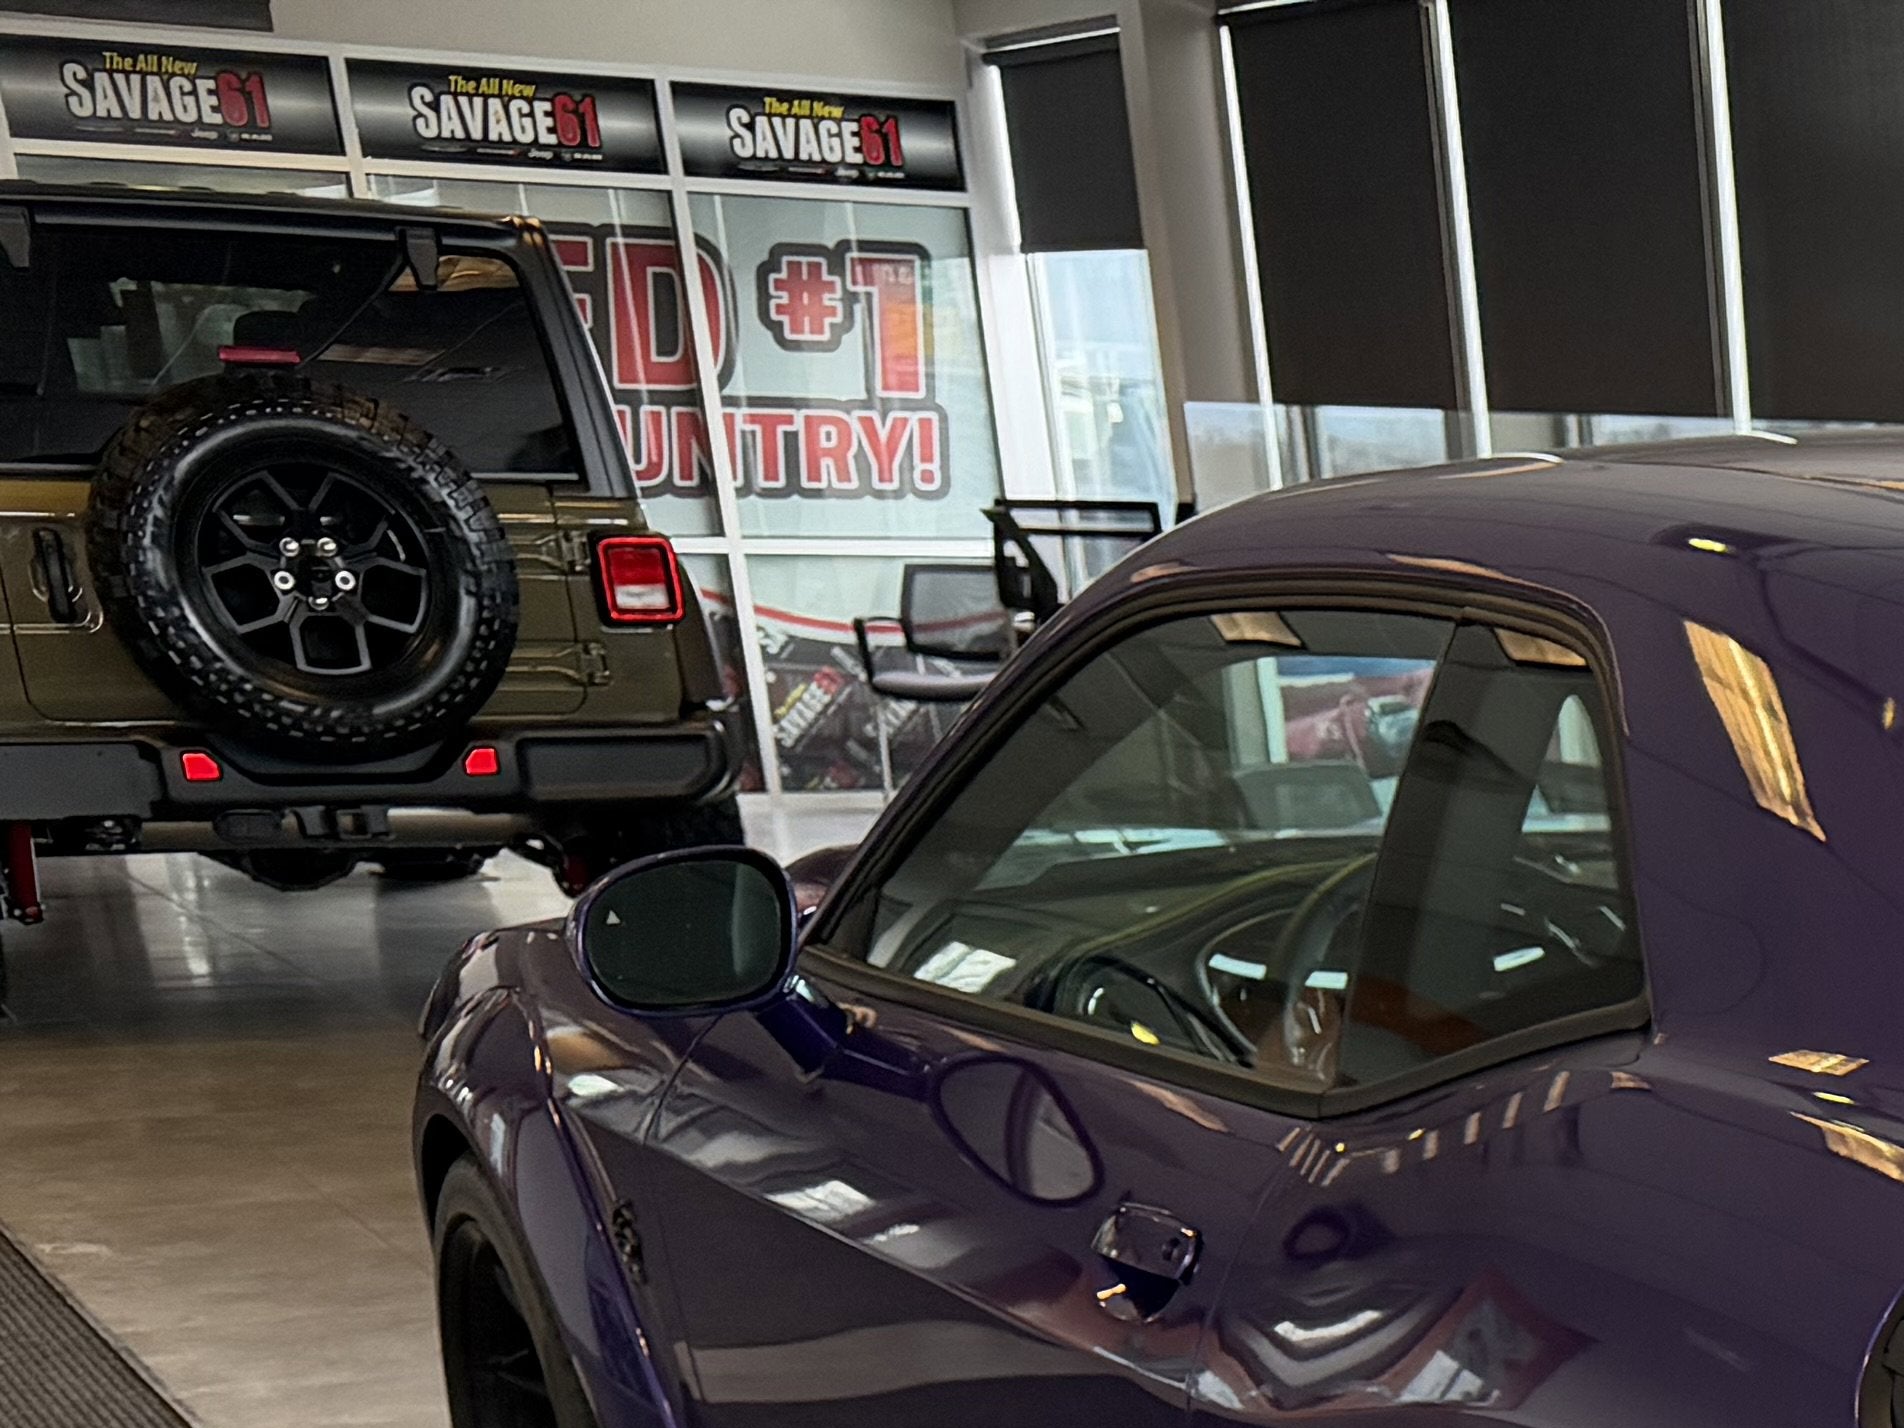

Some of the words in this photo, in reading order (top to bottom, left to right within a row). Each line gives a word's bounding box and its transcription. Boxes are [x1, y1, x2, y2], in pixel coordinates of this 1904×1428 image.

[102, 50, 133, 72] The
[136, 53, 157, 73] All
[161, 56, 197, 76] New
[448, 75, 476, 94] The
[478, 77, 499, 95] All
[502, 79, 537, 98] New
[61, 61, 270, 128] SAVAGE61
[410, 86, 600, 148] SAVAGE61
[763, 96, 790, 116] The
[791, 99, 812, 118] All
[812, 100, 846, 120] New
[728, 107, 904, 167] SAVAGE61
[768, 253, 926, 399] #1
